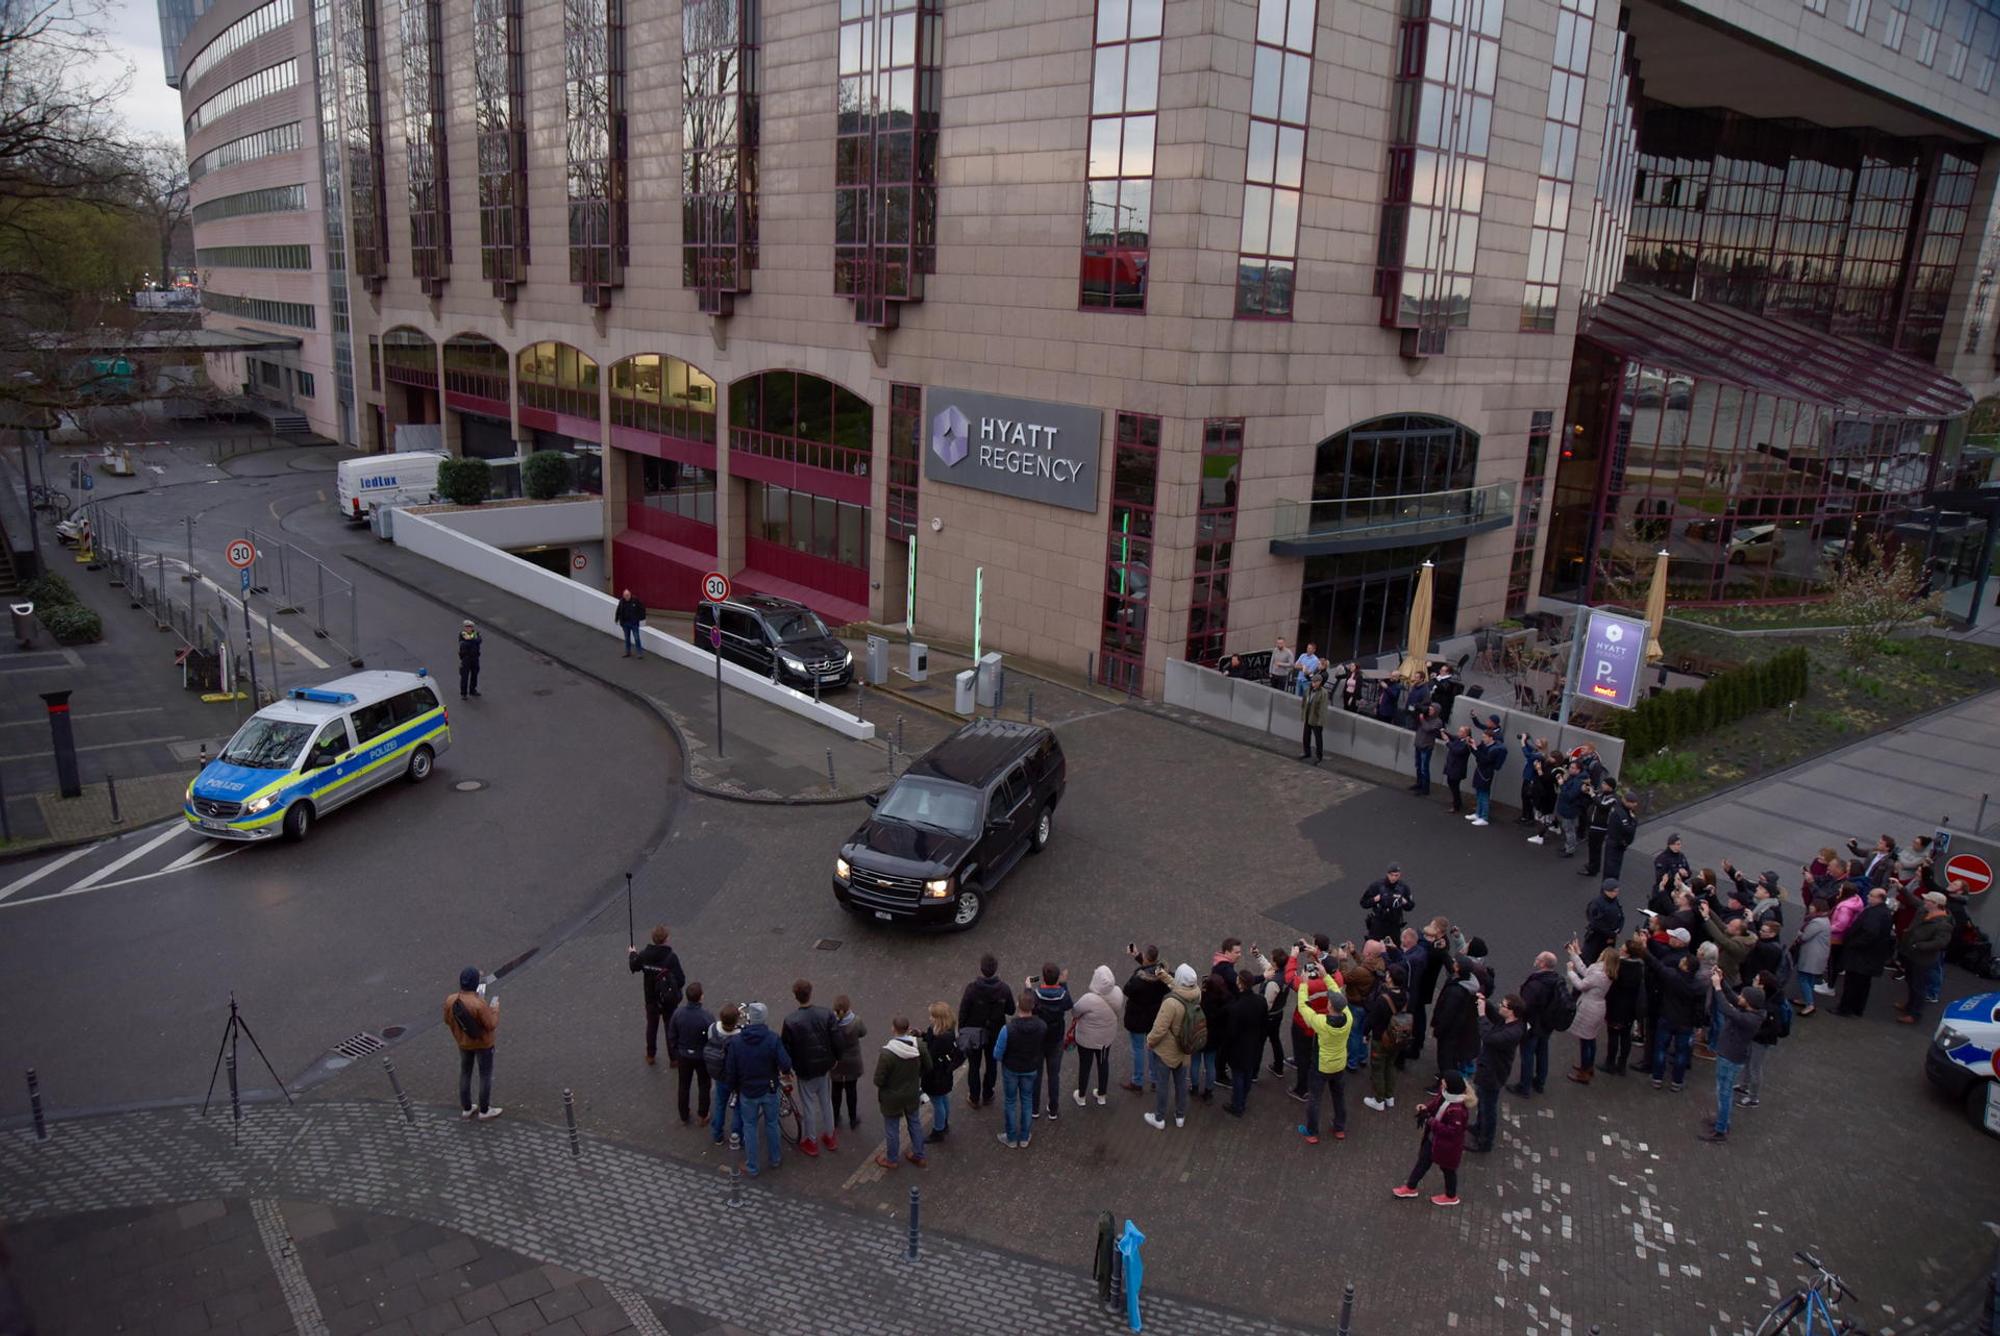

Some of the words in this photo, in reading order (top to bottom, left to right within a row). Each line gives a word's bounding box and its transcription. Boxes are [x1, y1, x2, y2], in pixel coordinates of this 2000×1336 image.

[980, 417, 1057, 449] HYATT
[979, 445, 1082, 483] REGENCY
[232, 547, 250, 561] 30
[708, 580, 724, 595] 30
[1596, 642, 1627, 655] HYATT
[1596, 660, 1612, 680] P
[369, 739, 398, 761] POLIZEI
[207, 779, 246, 791] POLIZEI
